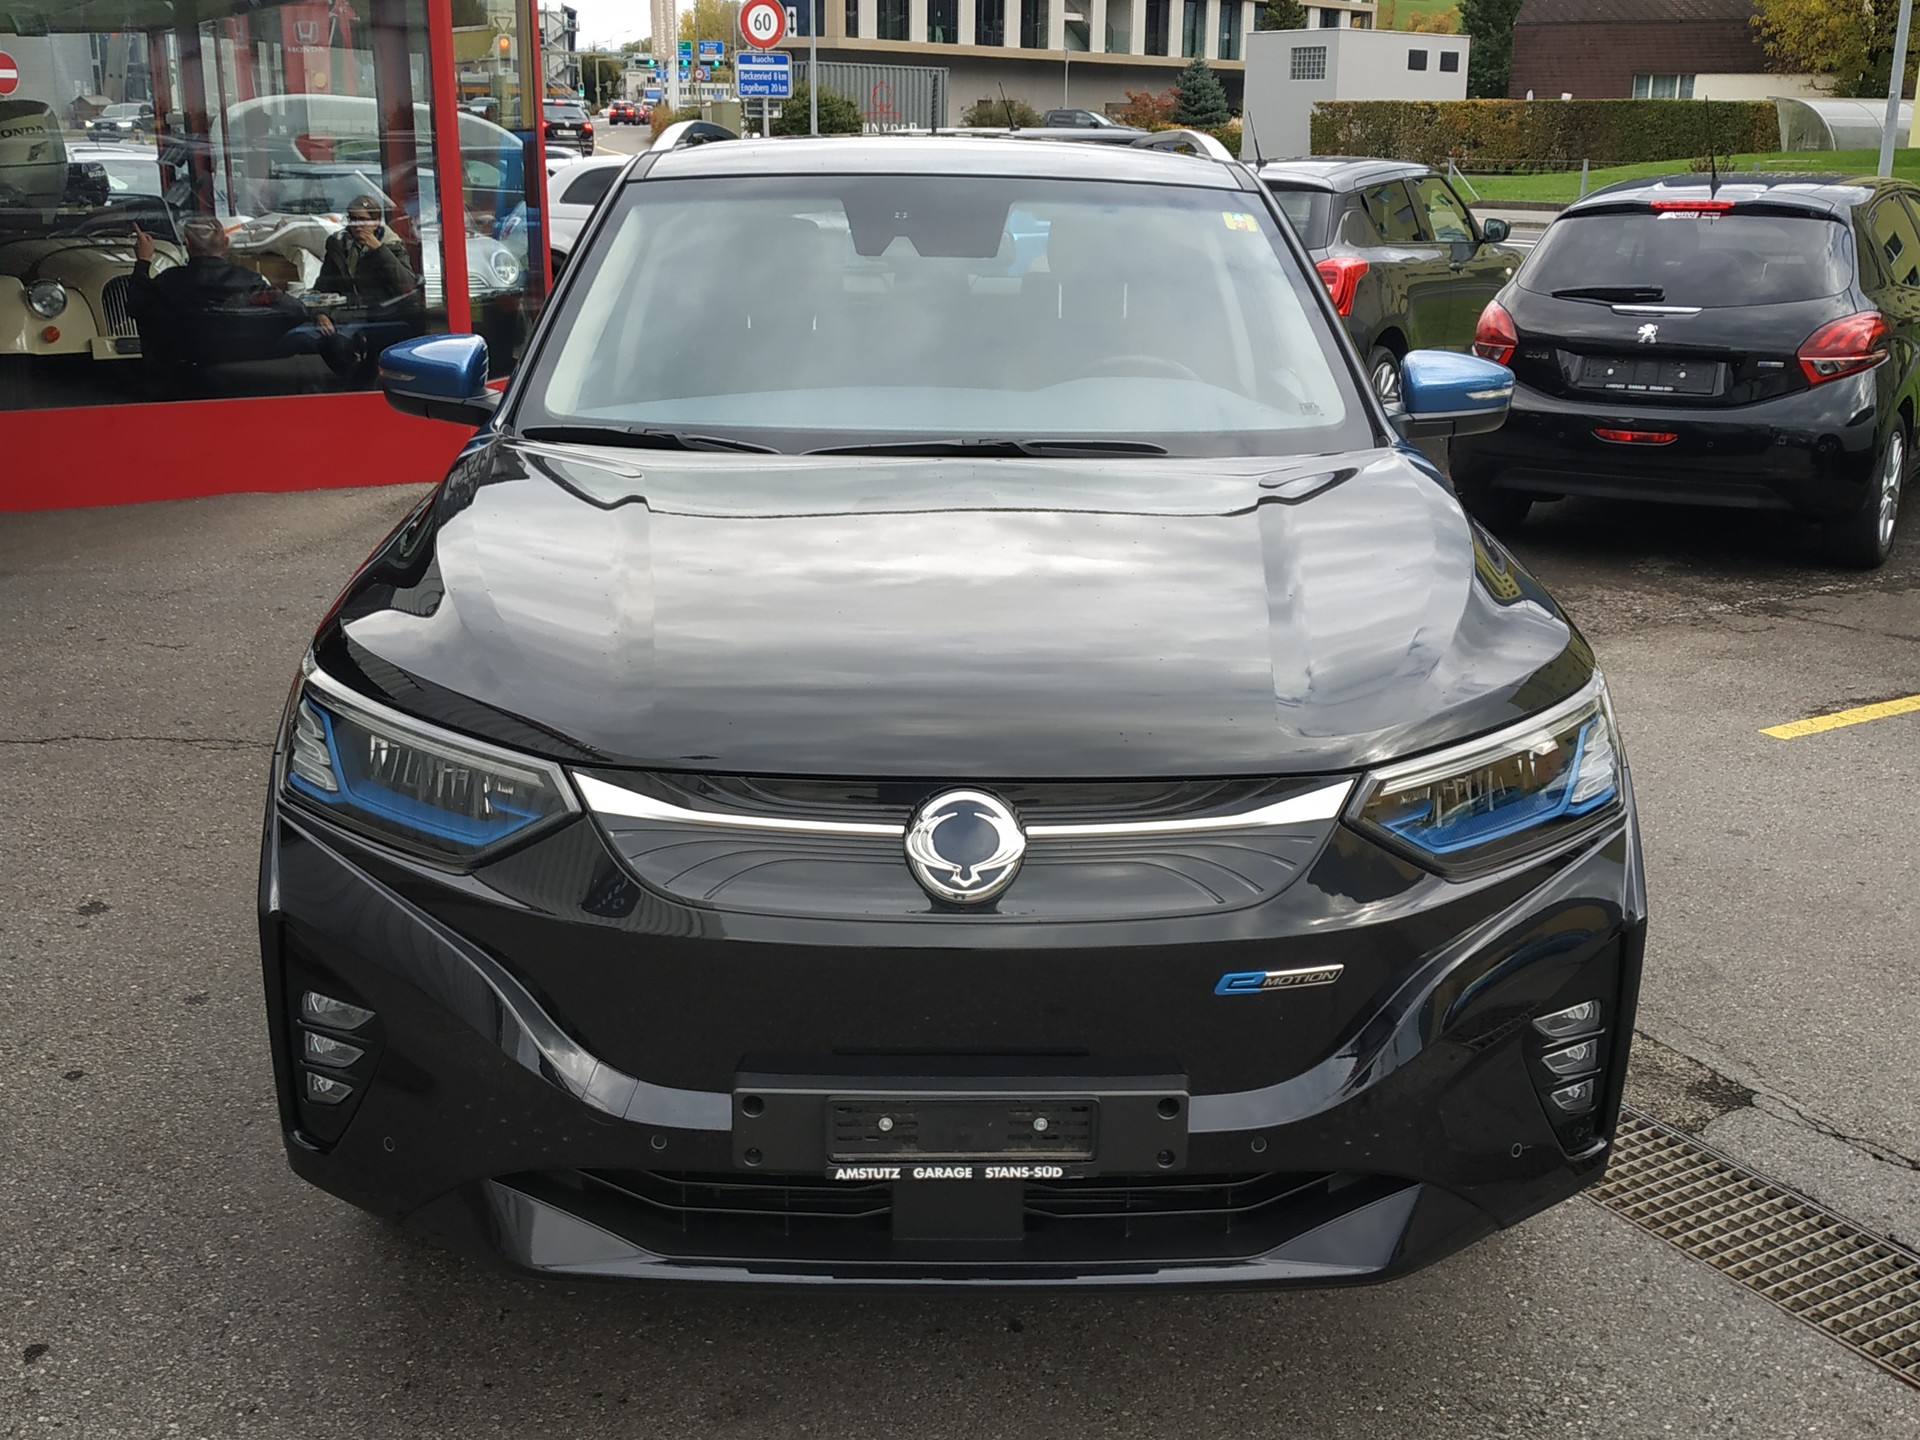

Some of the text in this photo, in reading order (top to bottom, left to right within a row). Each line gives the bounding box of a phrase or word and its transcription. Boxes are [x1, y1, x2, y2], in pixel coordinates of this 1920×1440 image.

[754, 12, 772, 32] 60
[752, 55, 775, 64] Buochs
[740, 71, 788, 81] Beckenried 8 km
[740, 83, 788, 94] Engelberg 20 km
[0, 125, 45, 139] ONDA
[1525, 350, 1549, 359] 208
[834, 1165, 1064, 1180] AMSTUTZ GARAGE STANS-SÜD
